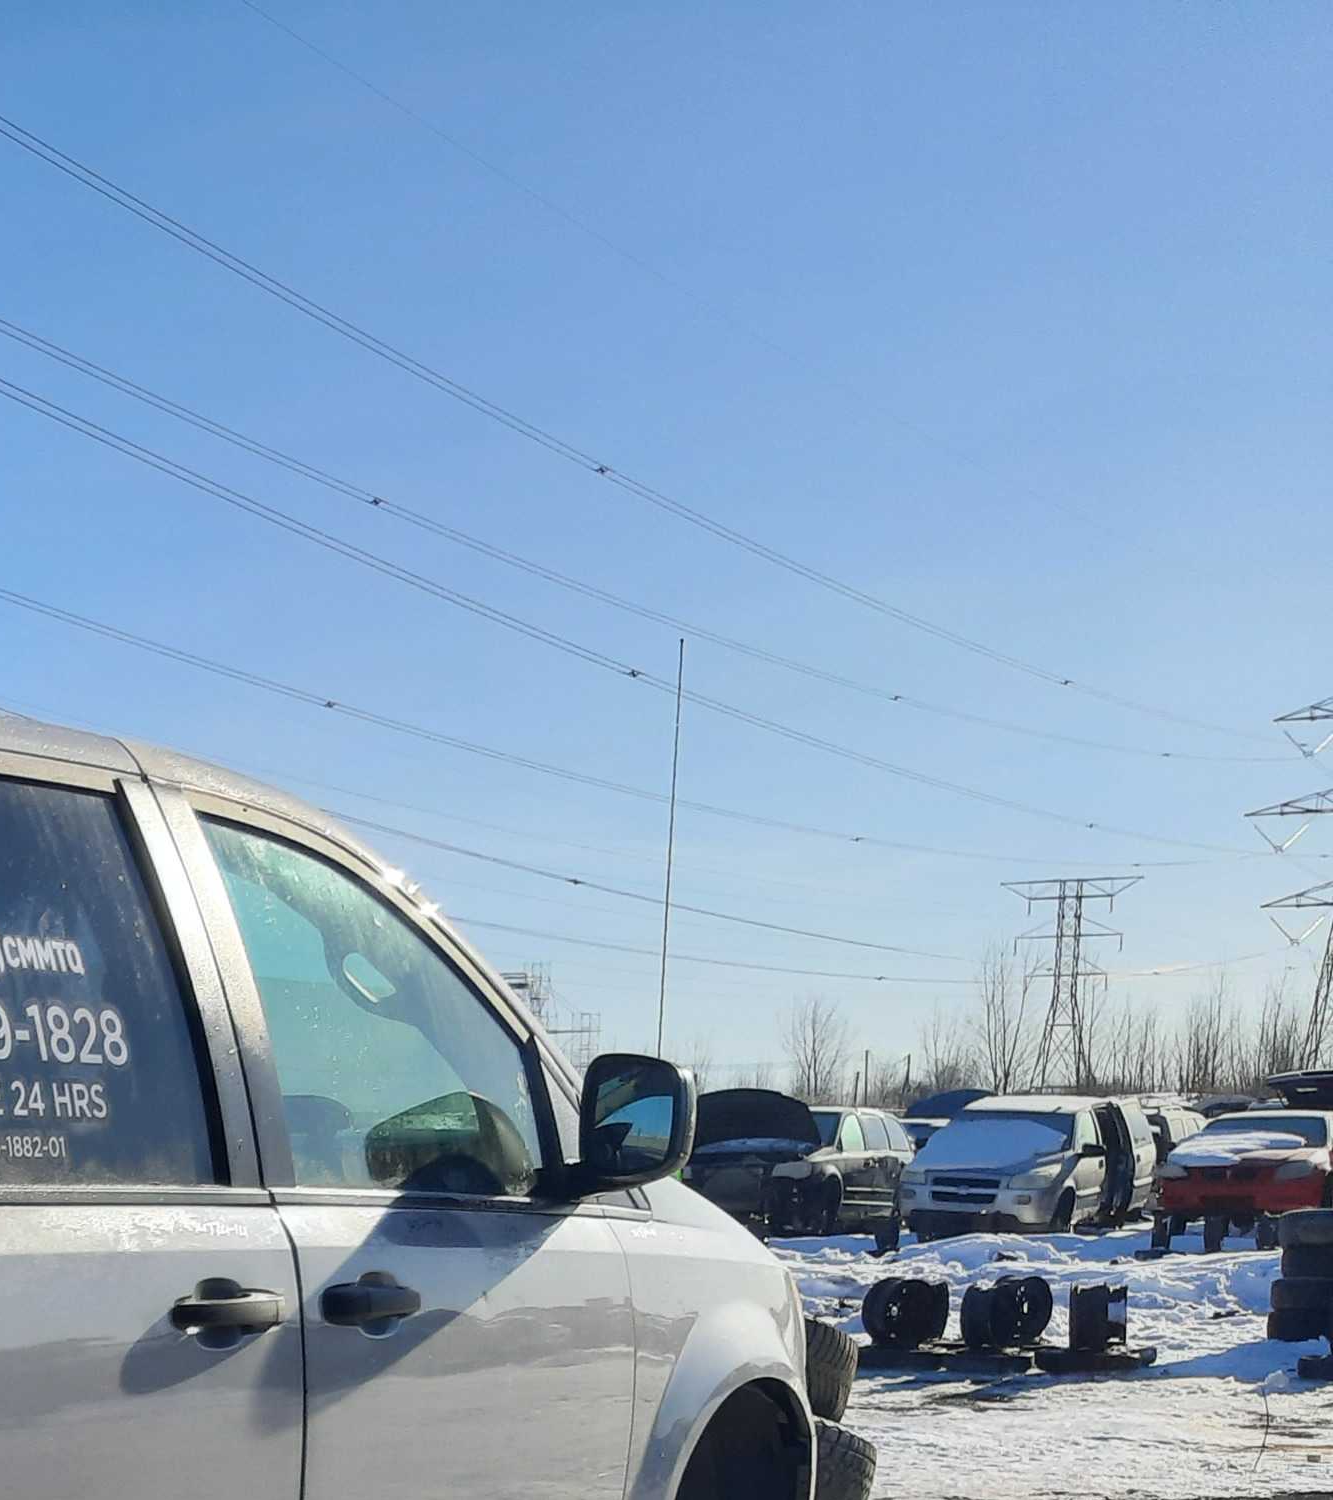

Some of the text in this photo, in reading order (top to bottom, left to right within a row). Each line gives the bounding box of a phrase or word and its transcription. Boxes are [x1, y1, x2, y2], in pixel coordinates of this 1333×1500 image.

[2, 935, 85, 975] CMMTQ
[11, 1084, 46, 1118] 24
[52, 1083, 108, 1120] HRS
